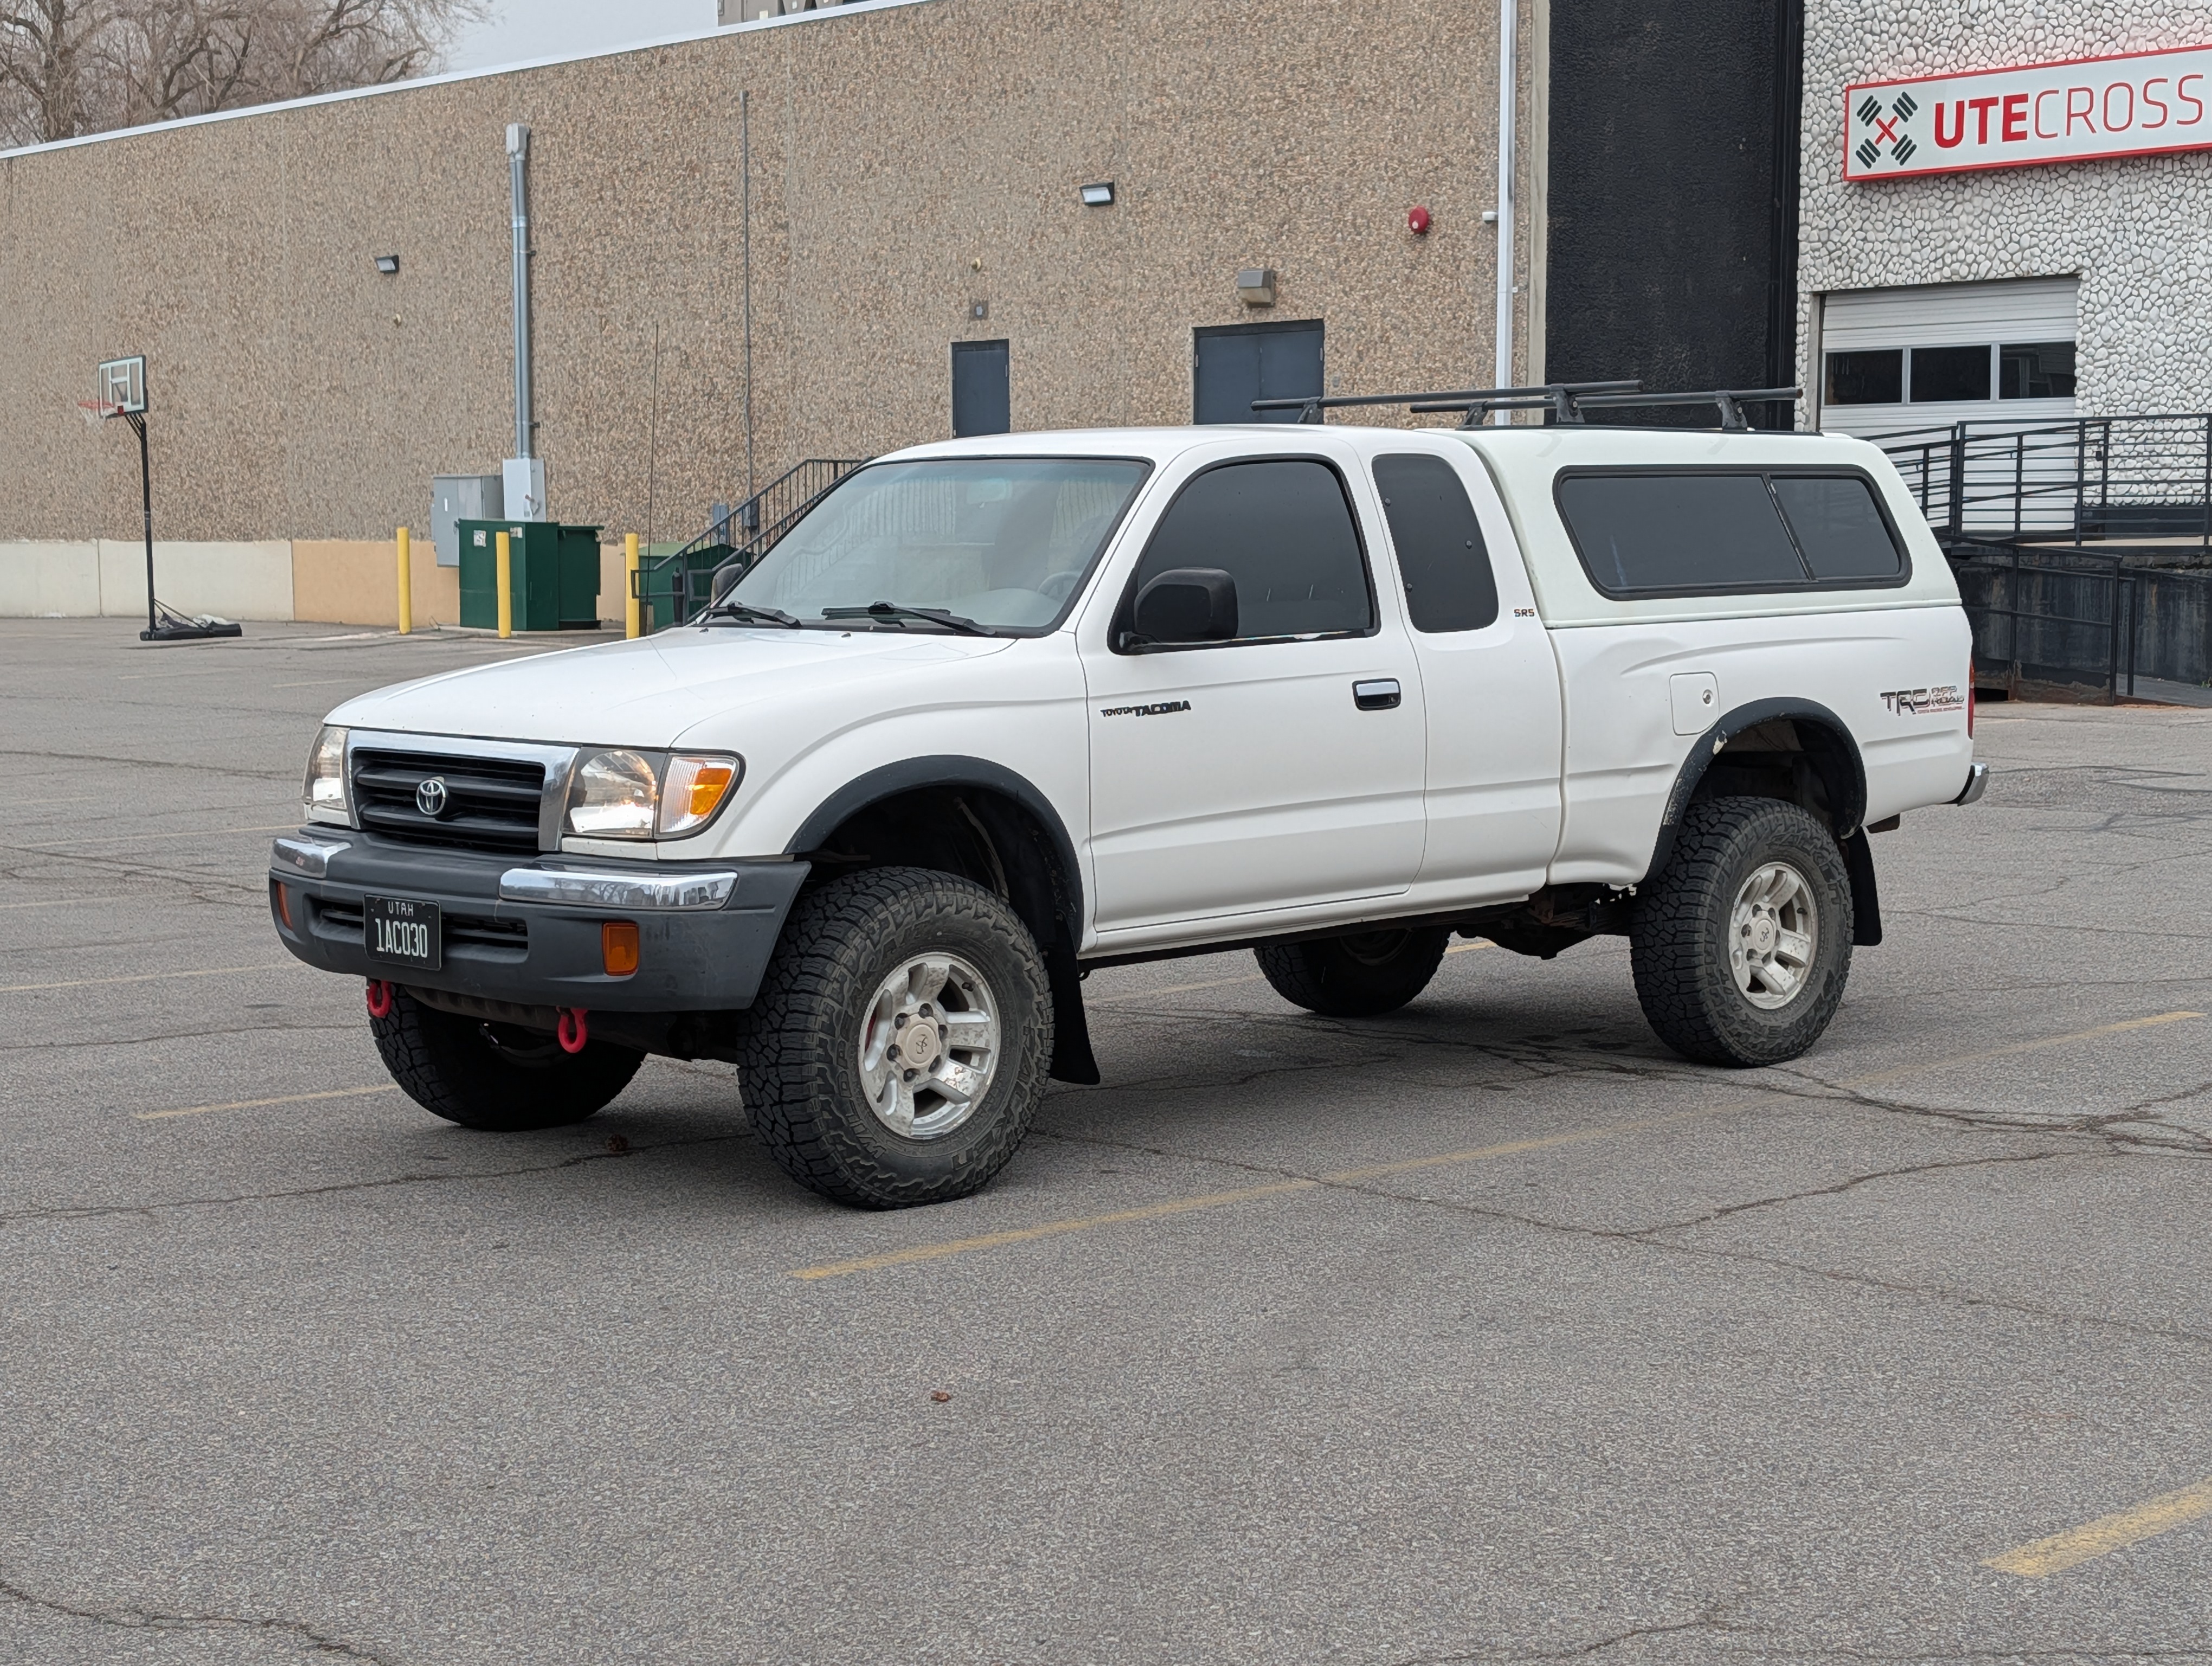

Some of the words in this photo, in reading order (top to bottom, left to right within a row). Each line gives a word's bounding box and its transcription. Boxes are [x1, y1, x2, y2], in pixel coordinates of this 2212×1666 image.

[1514, 608, 1535, 617] SR5
[1131, 700, 1191, 717] TACOMA
[1880, 688, 1930, 716] TRD
[388, 901, 414, 917] UTAH
